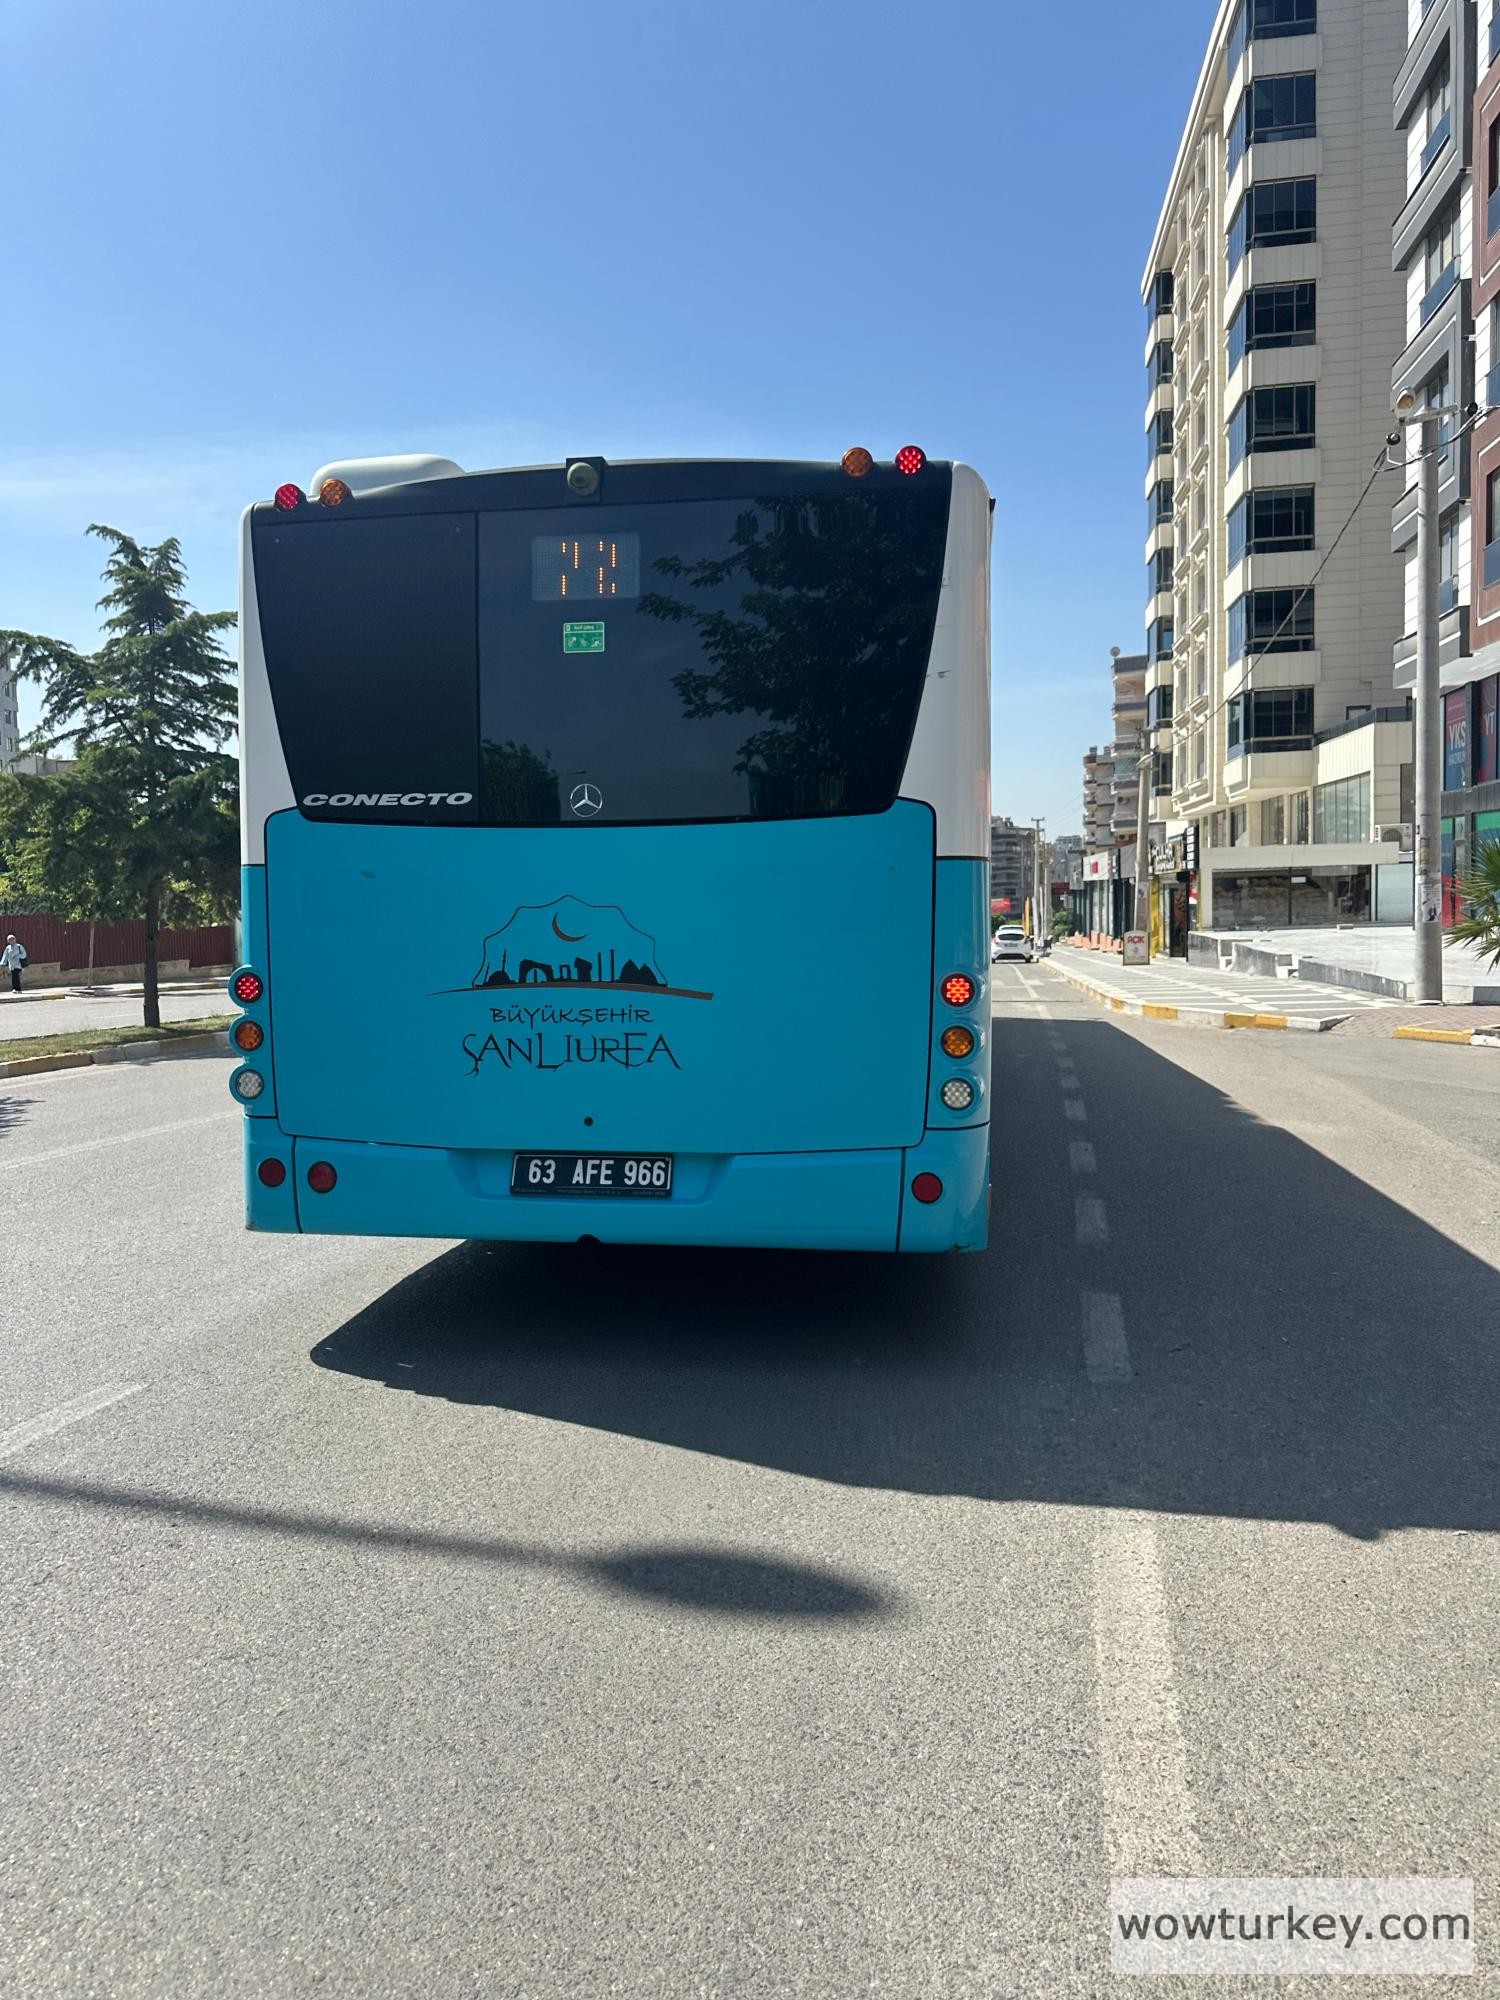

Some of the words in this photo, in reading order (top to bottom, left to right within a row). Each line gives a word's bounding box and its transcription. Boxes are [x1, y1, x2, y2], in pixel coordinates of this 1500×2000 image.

[1449, 721, 1466, 751] YKS
[302, 792, 473, 807] CONECTO
[489, 1005, 654, 1030] BÜYÜKŞEHİR
[462, 1032, 683, 1077] ŞANLIURFA
[528, 1159, 556, 1184] 63
[572, 1159, 615, 1185] AFE
[624, 1160, 666, 1186] 966
